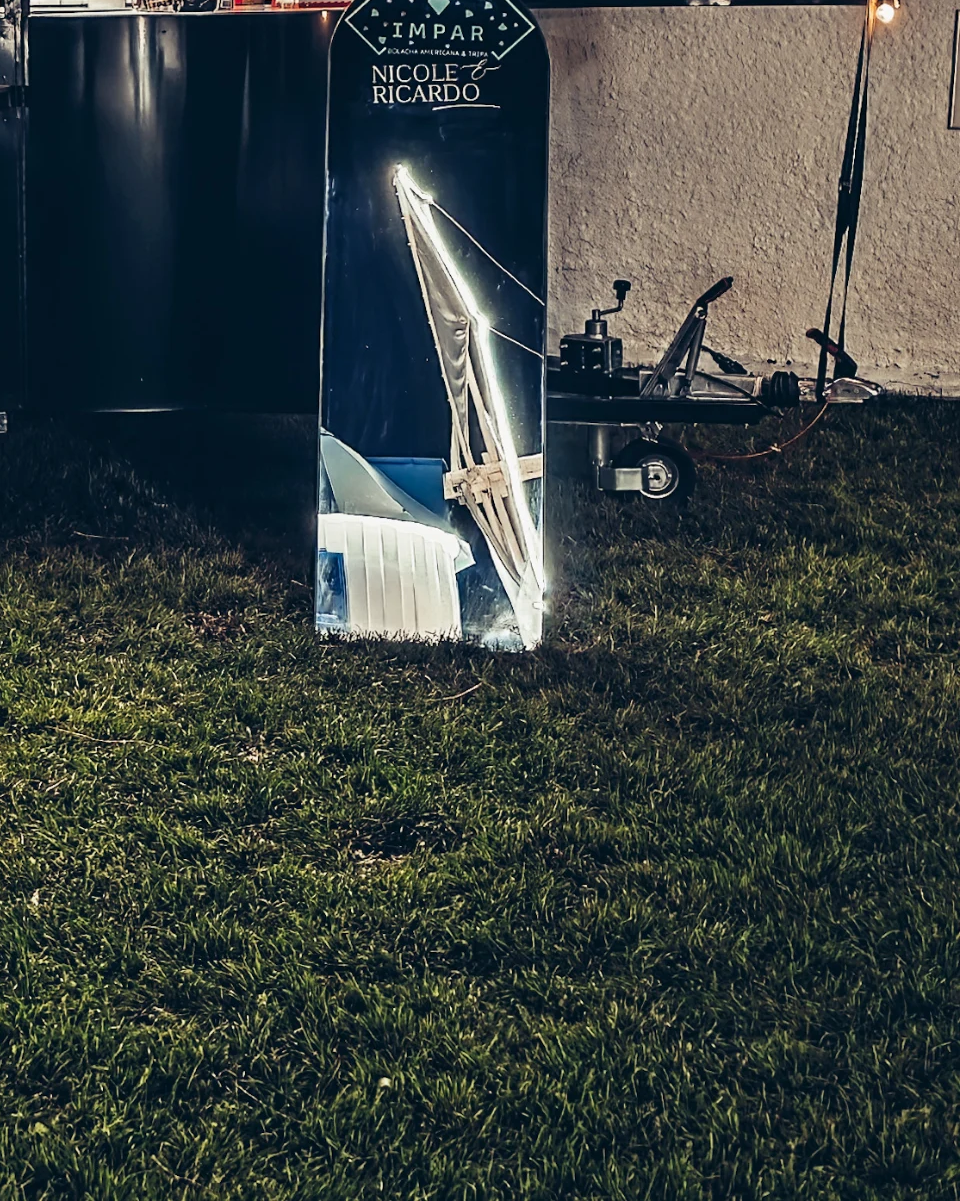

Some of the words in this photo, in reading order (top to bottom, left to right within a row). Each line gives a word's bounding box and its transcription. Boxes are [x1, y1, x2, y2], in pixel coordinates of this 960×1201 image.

[392, 22, 484, 41] IMPAR
[420, 48, 460, 56] AMERICANA
[372, 63, 459, 83] NICOLE
[372, 83, 480, 104] RICARDO
